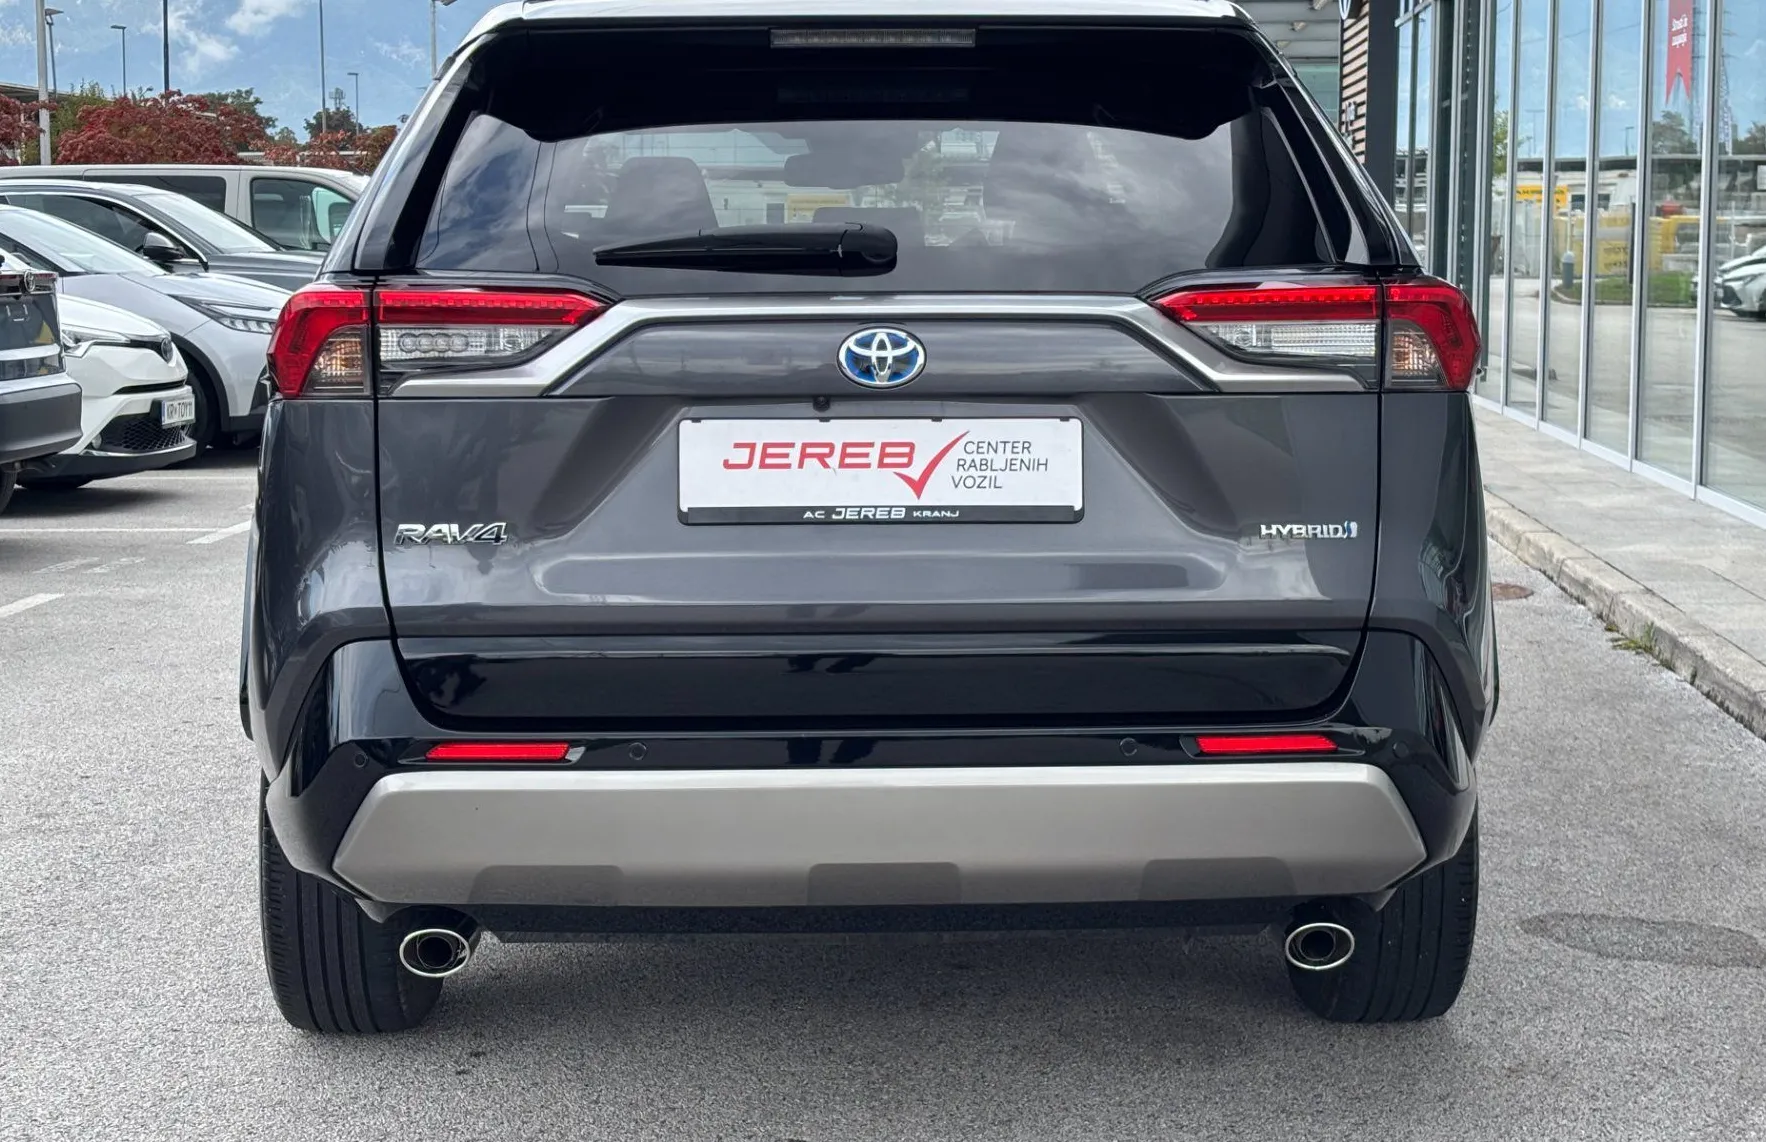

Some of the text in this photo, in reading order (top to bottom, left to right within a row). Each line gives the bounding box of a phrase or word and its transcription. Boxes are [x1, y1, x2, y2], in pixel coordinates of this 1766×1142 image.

[962, 440, 1032, 455] CENTER
[722, 441, 916, 470] JEREB
[955, 457, 1049, 472] RABLJENIH
[950, 475, 1003, 489] VOZIL
[802, 507, 960, 520] AC JEREB KRANJ
[394, 522, 507, 545] RAV4
[1260, 523, 1345, 539] HYBRID
